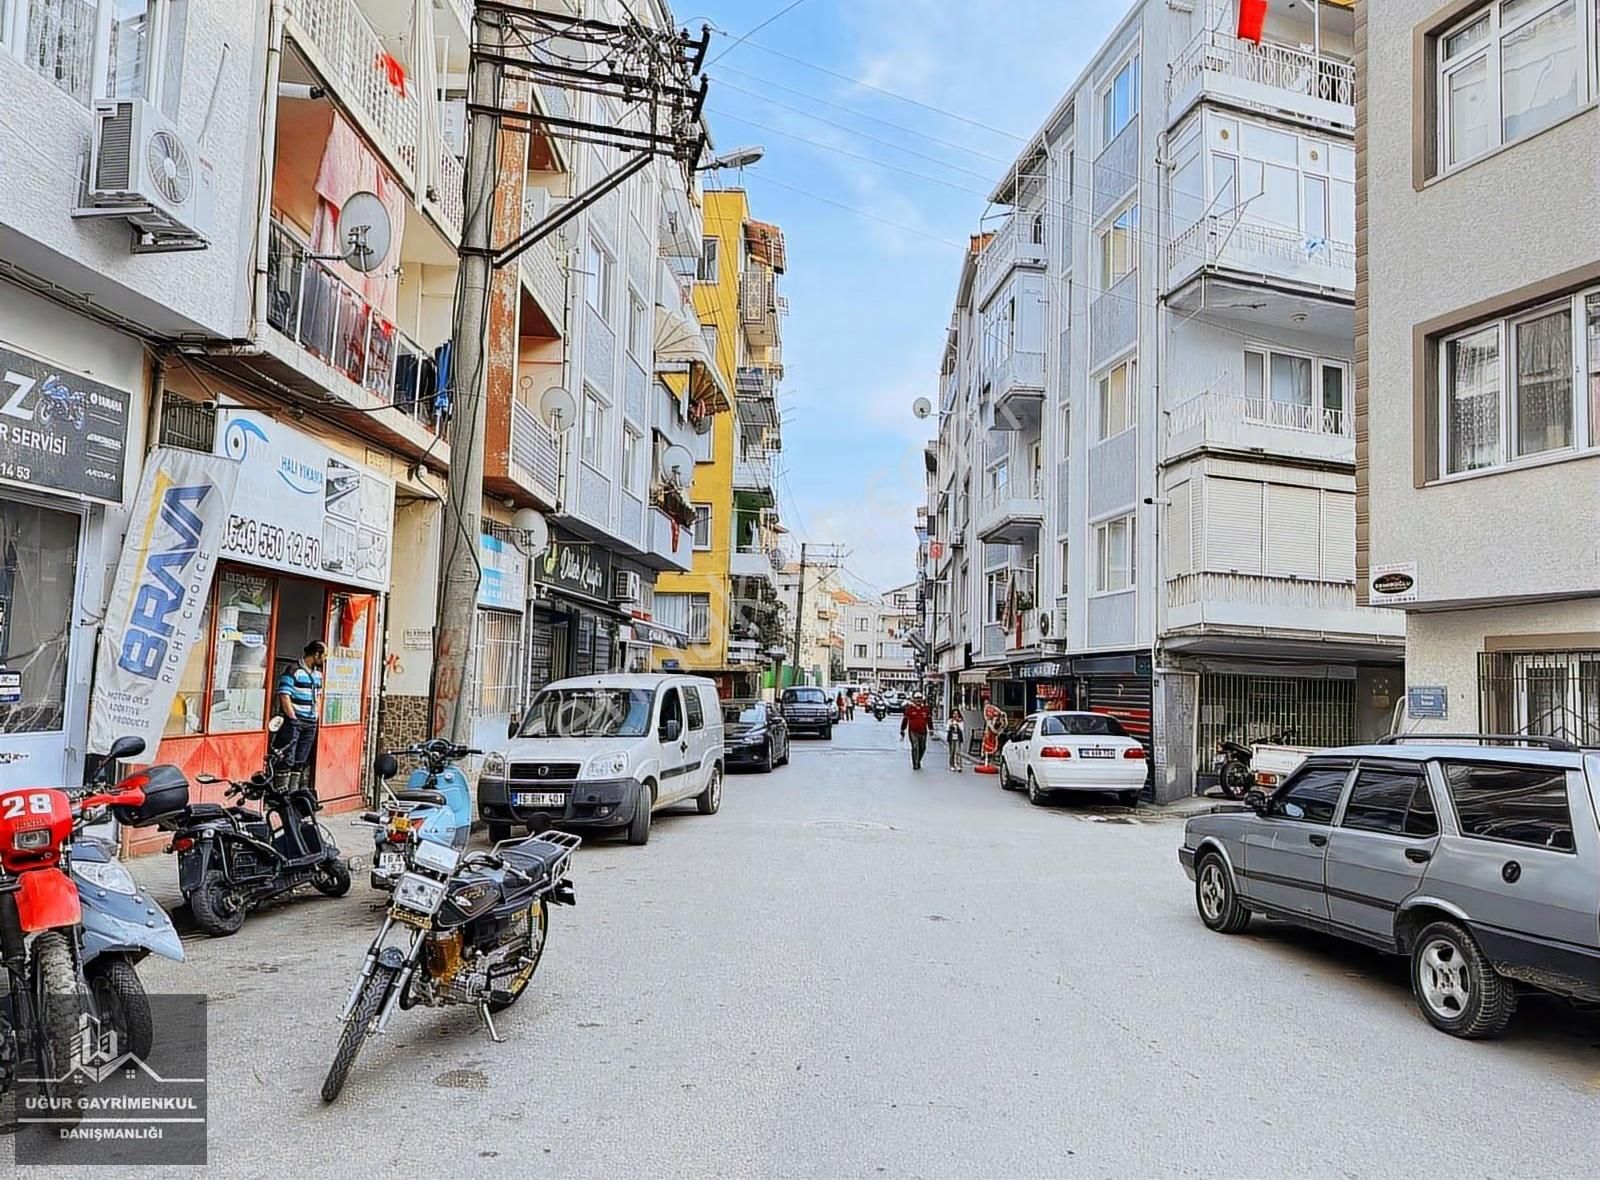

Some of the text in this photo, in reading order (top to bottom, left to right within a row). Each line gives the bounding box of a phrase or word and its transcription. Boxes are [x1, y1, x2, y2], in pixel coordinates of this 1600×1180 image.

[12, 427, 67, 456] SERVİSİ
[221, 515, 321, 571] 546 550 12 50
[118, 484, 211, 680] BRAVA
[162, 550, 210, 683] RIGHT CHOICE
[2, 793, 53, 819] 28
